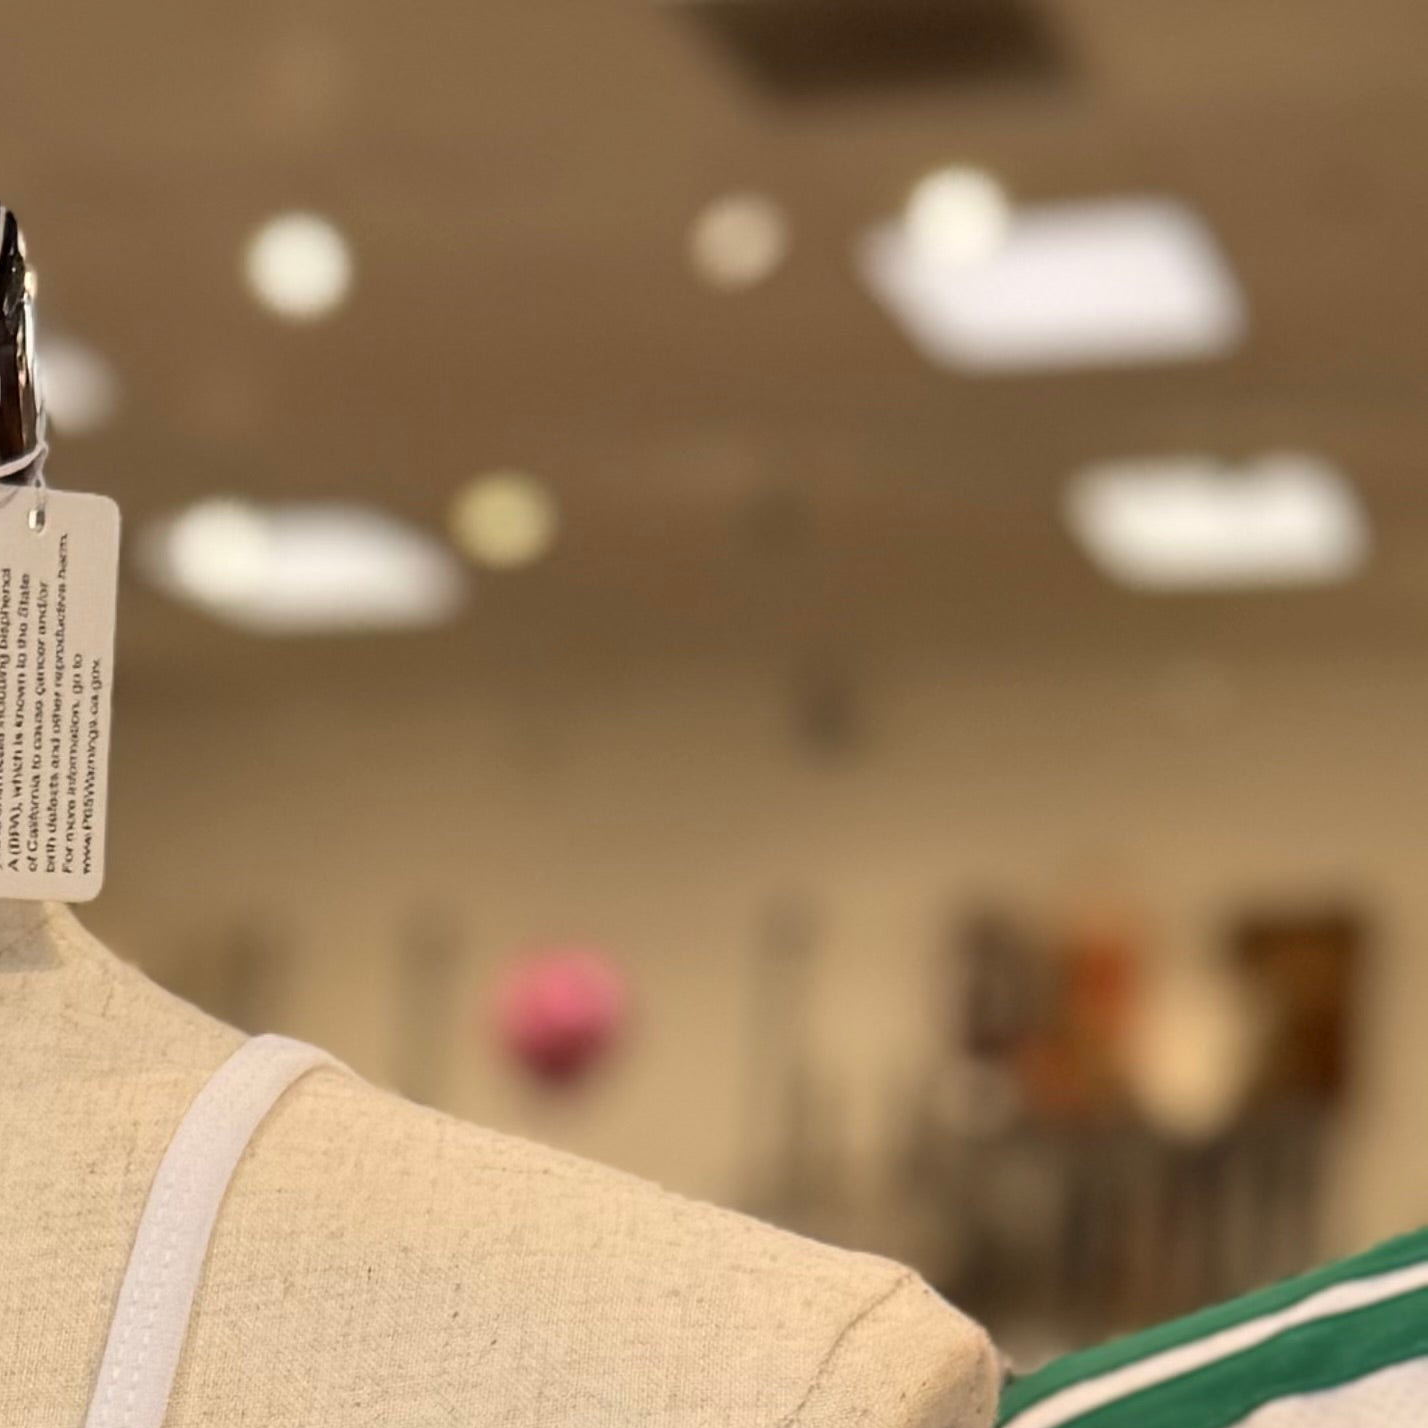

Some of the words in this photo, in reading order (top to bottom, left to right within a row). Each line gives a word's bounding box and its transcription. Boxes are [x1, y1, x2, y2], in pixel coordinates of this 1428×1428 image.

[17, 573, 30, 618] State
[37, 580, 49, 635] and/or
[16, 623, 29, 649] the
[53, 583, 67, 688] reproductive
[16, 653, 28, 669] to
[35, 639, 47, 696] cancer
[72, 653, 83, 670] to
[14, 672, 28, 728] known
[71, 672, 83, 694] go
[33, 701, 43, 750] cause
[52, 692, 63, 733] other
[14, 733, 24, 745] is
[50, 738, 61, 768] and
[11, 750, 24, 798] which
[31, 754, 42, 770] to
[27, 773, 41, 852] California
[46, 772, 59, 834] defects
[65, 800, 76, 842] more
[27, 856, 38, 872] of
[45, 837, 57, 873] birth
[62, 848, 74, 874] For
